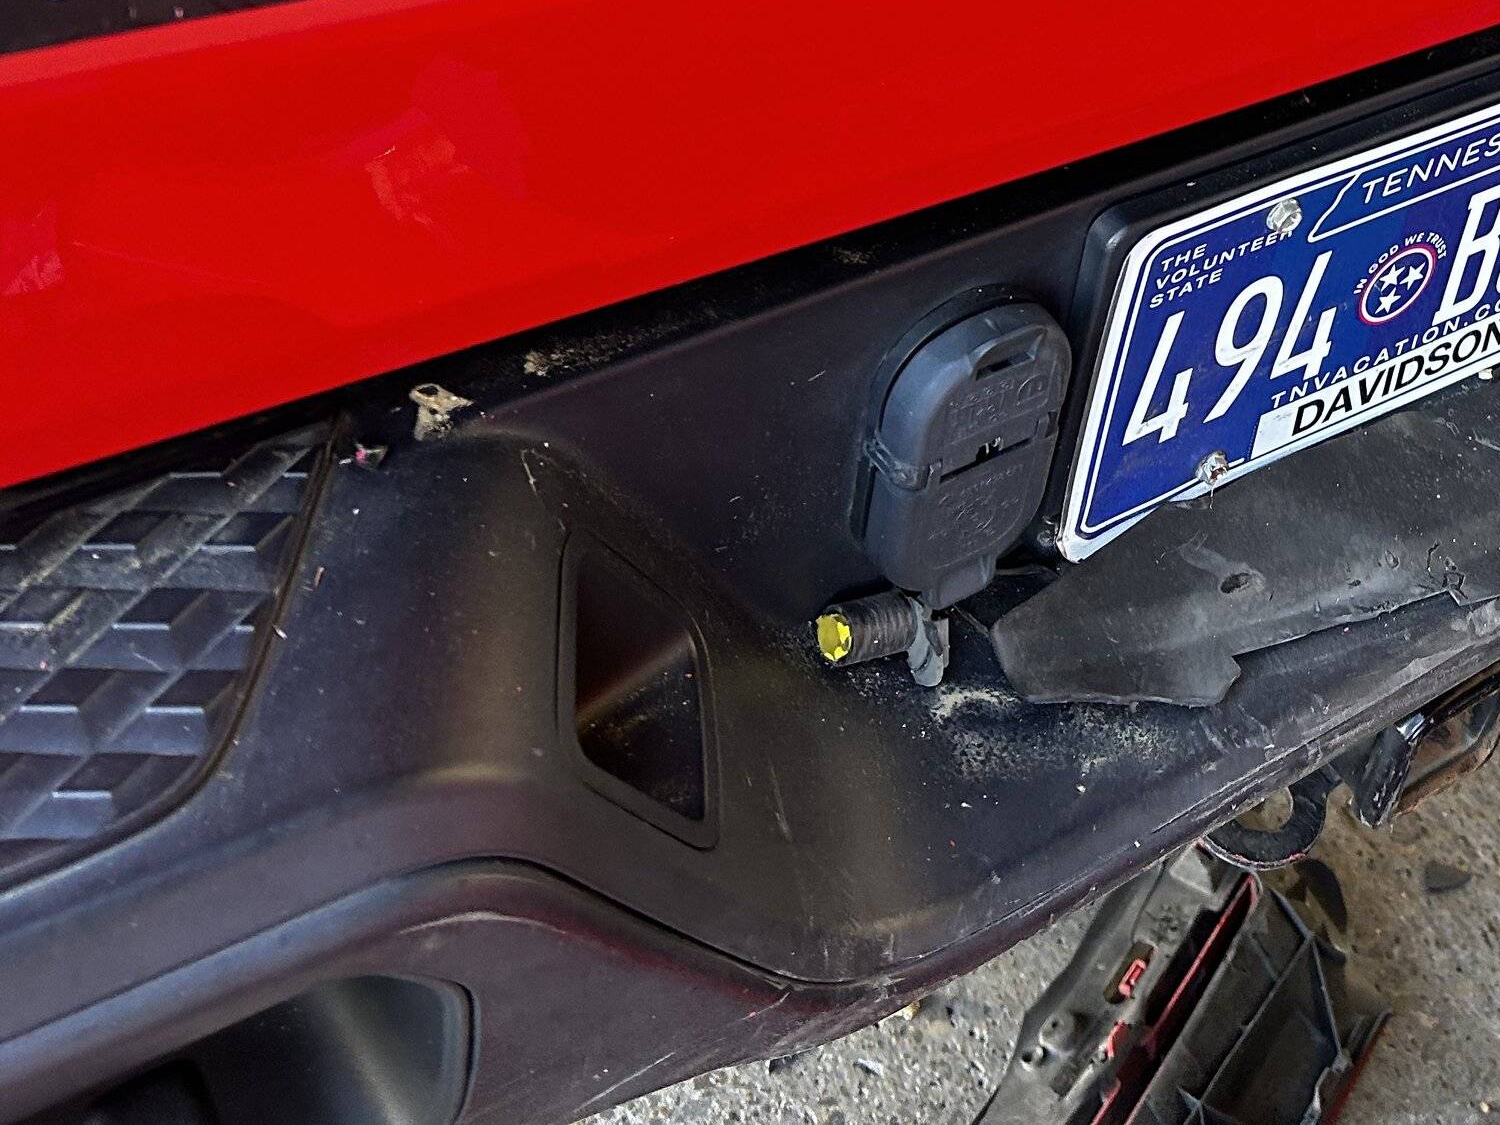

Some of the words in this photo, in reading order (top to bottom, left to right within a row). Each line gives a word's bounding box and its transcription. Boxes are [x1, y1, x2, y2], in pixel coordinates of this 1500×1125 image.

[1161, 243, 1208, 273] THE
[1353, 278, 1368, 295] IN
[1368, 244, 1399, 274] GOD
[1404, 232, 1425, 247] WE
[1425, 232, 1447, 260] TRUST
[1149, 268, 1224, 309] STATE
[1122, 250, 1337, 446] 494
